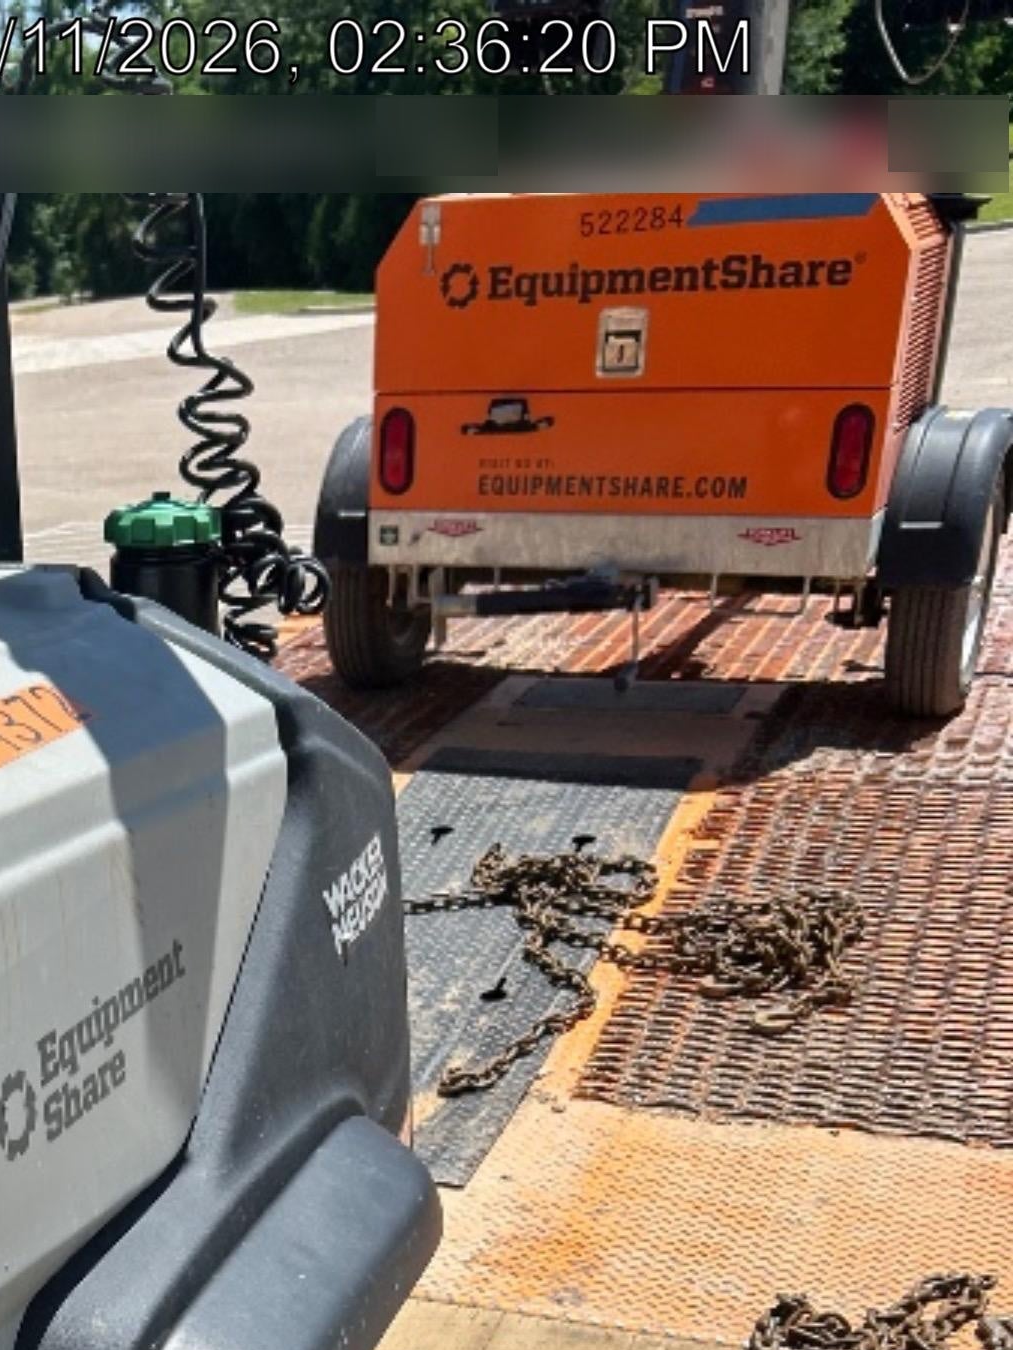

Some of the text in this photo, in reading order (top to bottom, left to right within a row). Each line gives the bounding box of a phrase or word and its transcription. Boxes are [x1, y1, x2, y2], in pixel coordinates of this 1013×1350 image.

[580, 205, 683, 238] 522284
[488, 254, 853, 306] EquipmentShare
[477, 474, 749, 499] EQUIPMENTSHARE.COM
[322, 831, 384, 919] WACKER
[36, 938, 186, 1088] Equipment
[43, 1049, 126, 1143] Share
